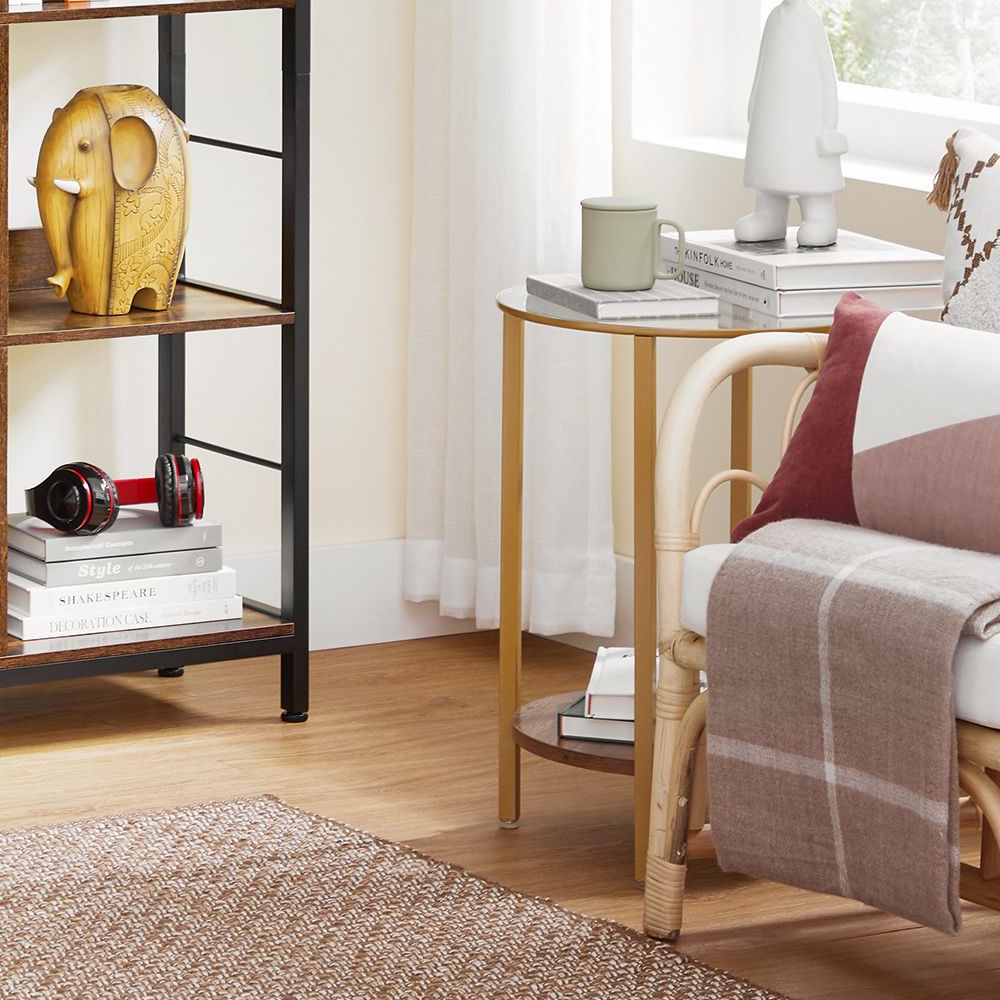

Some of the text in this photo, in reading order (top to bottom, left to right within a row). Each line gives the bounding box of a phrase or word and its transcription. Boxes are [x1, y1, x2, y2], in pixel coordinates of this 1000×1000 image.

[685, 248, 719, 267] KINFOLK
[675, 270, 700, 289] OUSE
[77, 562, 121, 580] Style
[58, 587, 158, 606] SHAKESPEARE
[50, 613, 124, 634] DECORATION
[124, 611, 152, 625] CASE
